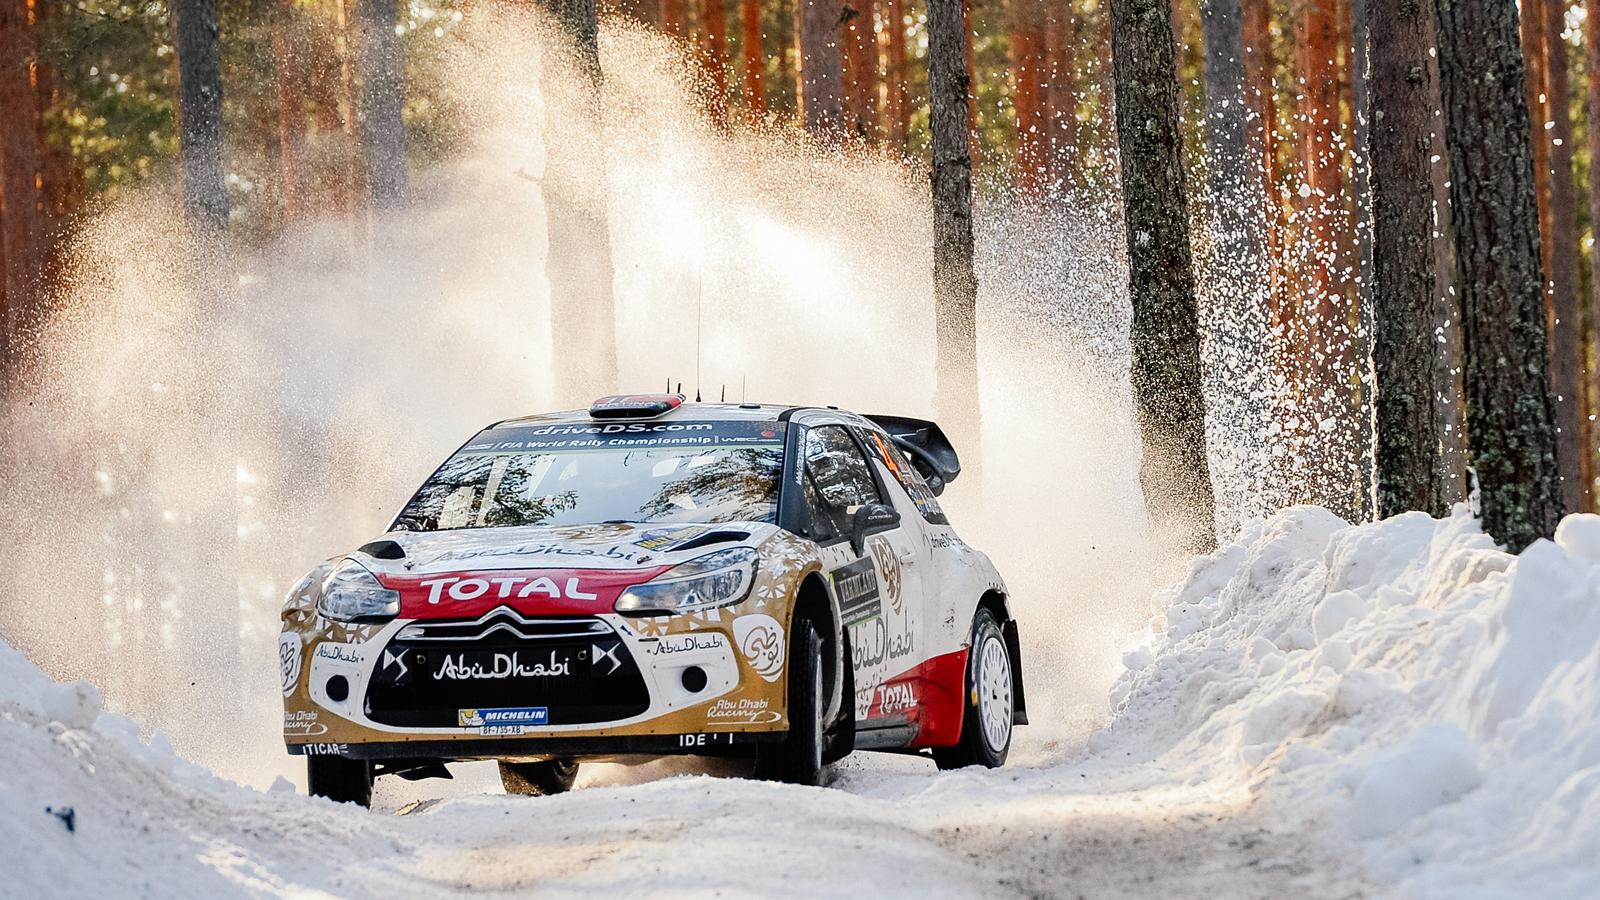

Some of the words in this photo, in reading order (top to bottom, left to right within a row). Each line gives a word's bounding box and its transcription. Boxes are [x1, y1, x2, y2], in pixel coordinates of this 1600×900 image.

[533, 423, 712, 436] driveDS.com
[501, 441, 523, 449] FIA
[526, 440, 567, 448] World
[569, 438, 605, 447] Rally
[608, 436, 711, 446] Championship
[420, 575, 598, 605] TOTAL
[716, 699, 737, 709] Abu
[738, 698, 769, 709] Dhabi
[877, 682, 918, 714] TOTAL
[485, 711, 546, 721] MICHELIN
